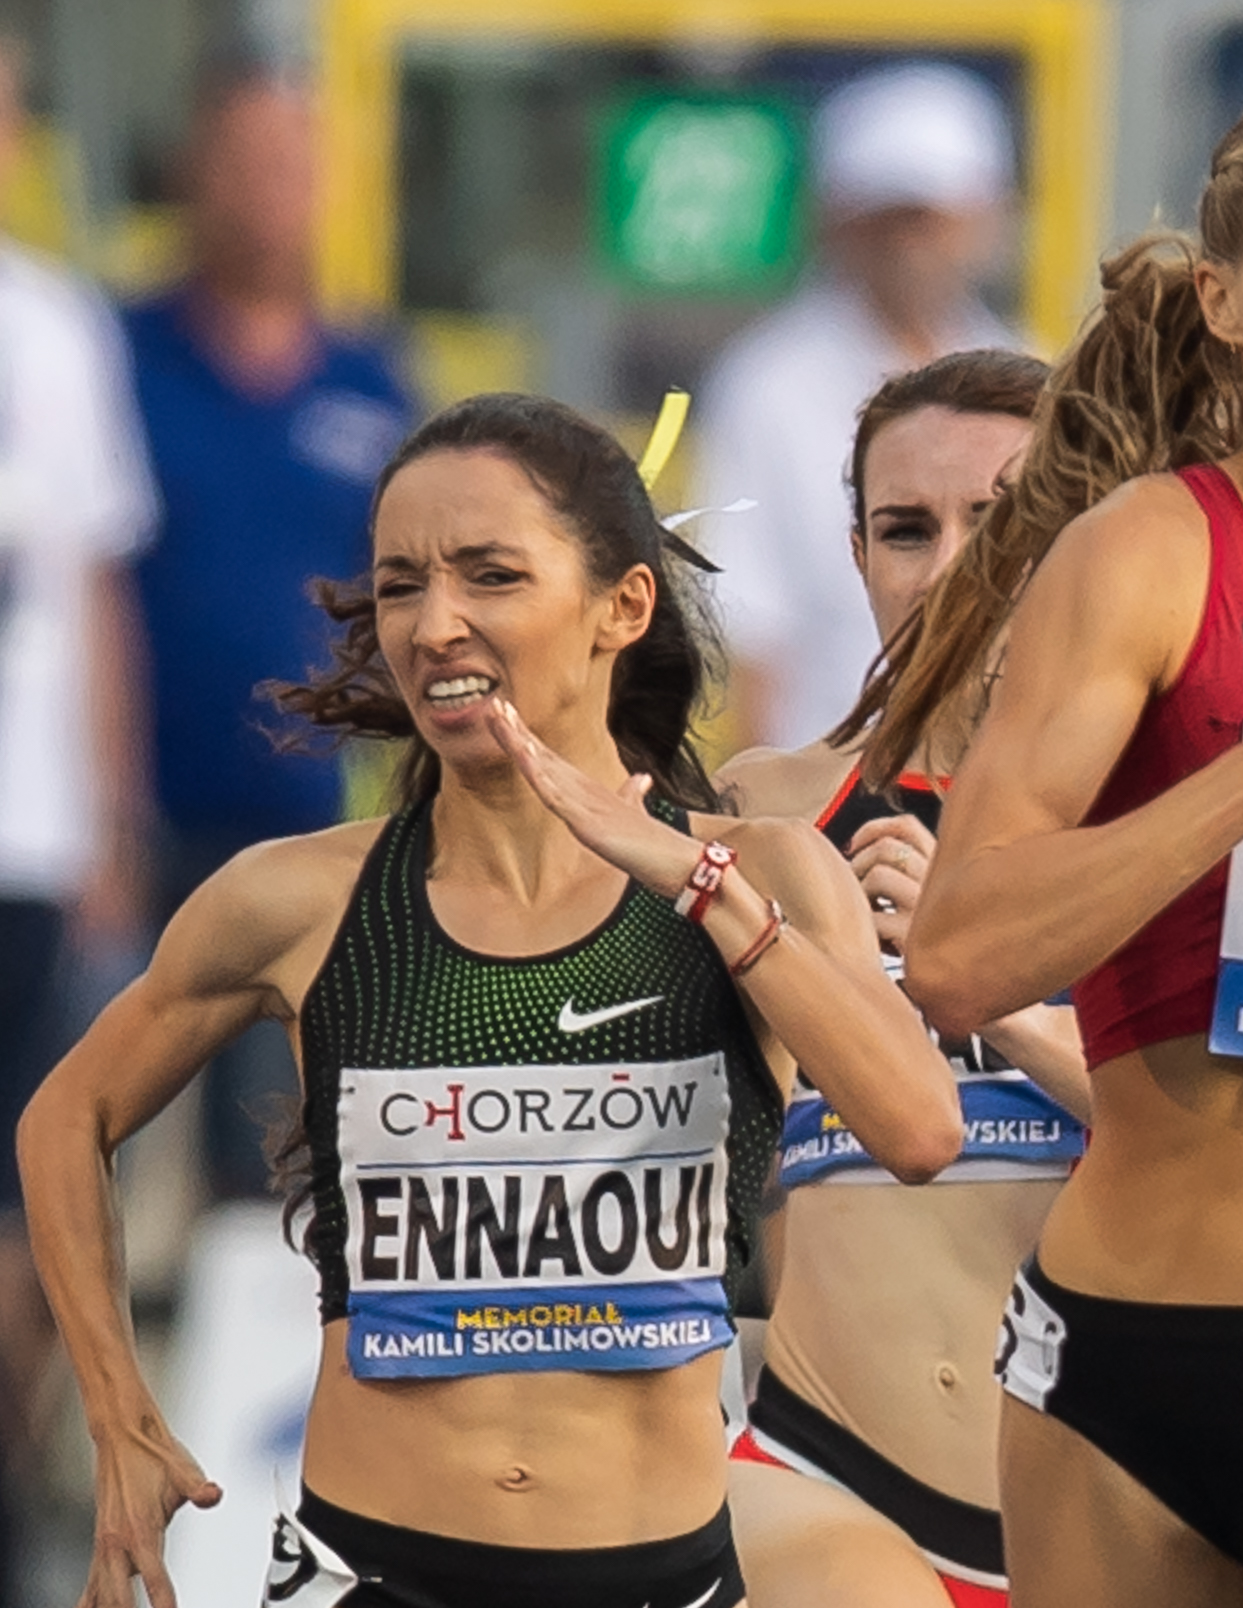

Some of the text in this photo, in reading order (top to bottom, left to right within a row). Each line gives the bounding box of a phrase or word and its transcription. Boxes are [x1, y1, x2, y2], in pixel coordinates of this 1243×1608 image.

[356, 1162, 715, 1282] ENNAOUI
[456, 1302, 623, 1330] MEMORIAŁ
[364, 1318, 712, 1358] KAMILI SKOLIMOWSKIEJ
